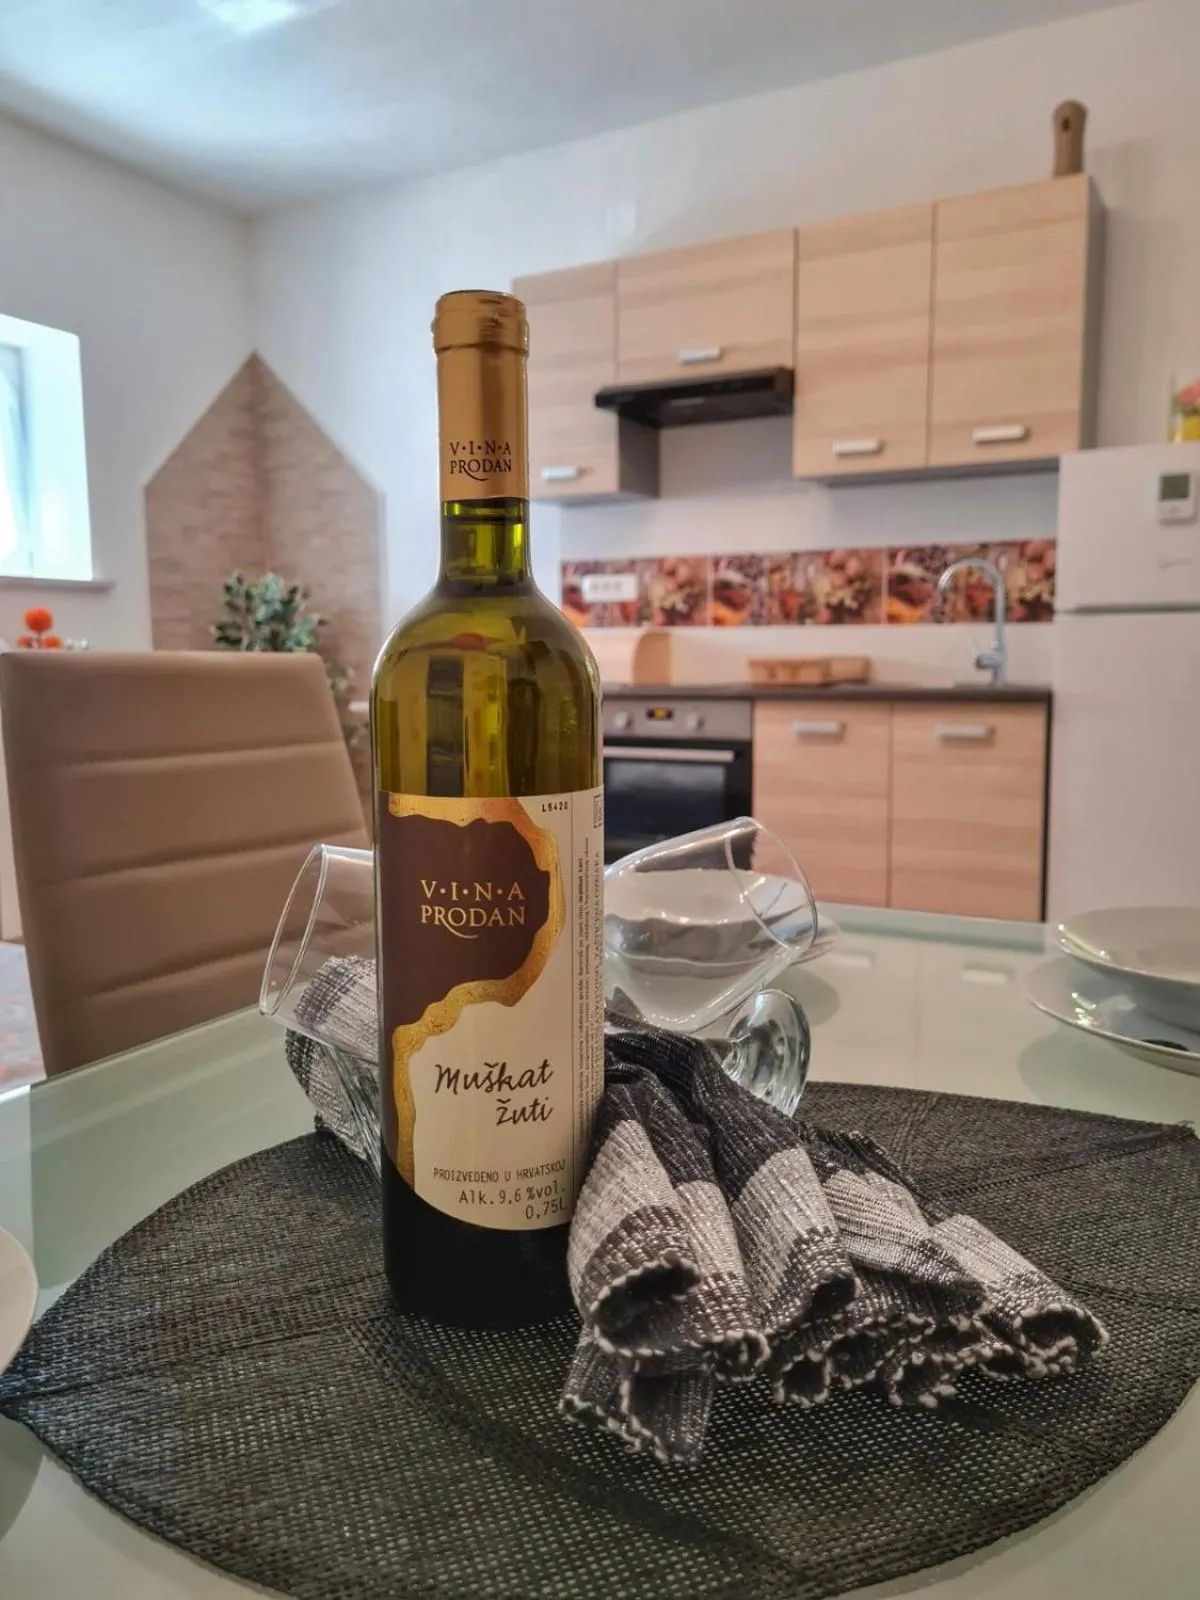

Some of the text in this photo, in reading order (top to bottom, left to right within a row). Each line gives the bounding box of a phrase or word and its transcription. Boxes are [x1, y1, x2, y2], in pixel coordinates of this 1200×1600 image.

[450, 459, 511, 481] PRODAN
[420, 904, 525, 939] PRODAN
[434, 1058, 554, 1095] Muškat
[433, 1159, 566, 1183] PROIZVEDENO U HRVATSKOJ
